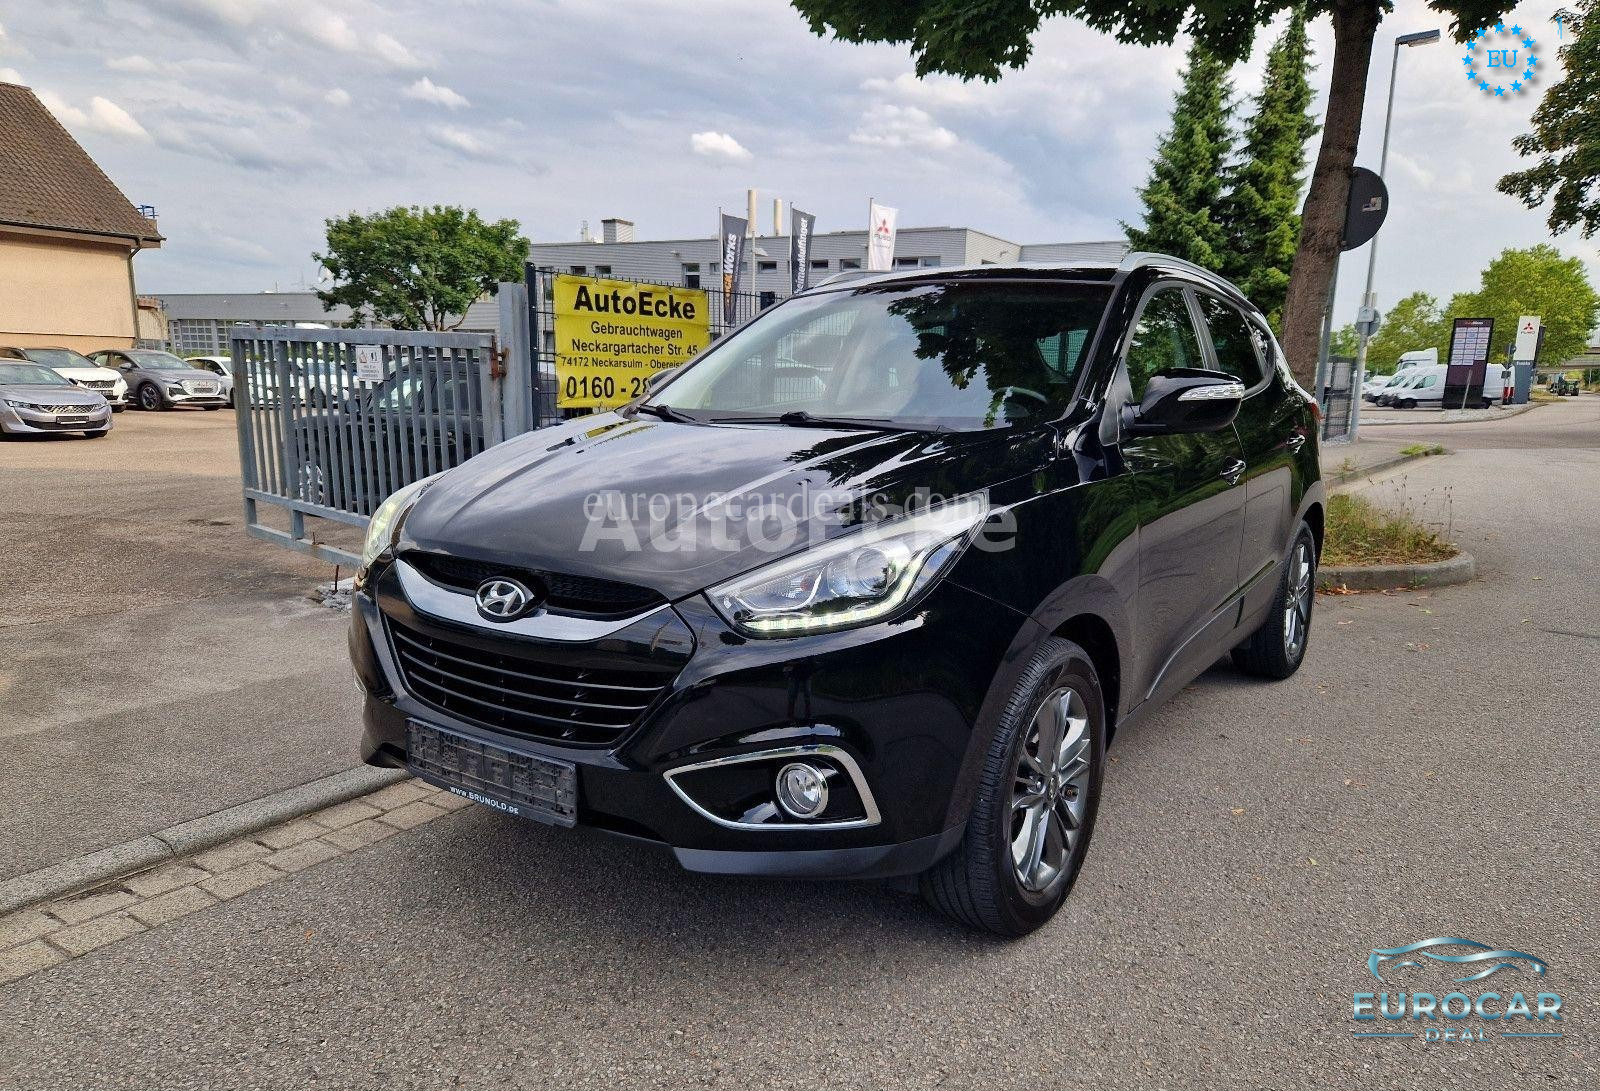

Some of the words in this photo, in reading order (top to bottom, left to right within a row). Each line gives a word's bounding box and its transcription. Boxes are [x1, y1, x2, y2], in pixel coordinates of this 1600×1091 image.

[574, 285, 696, 319] AutoEcke
[590, 321, 683, 340] Gebrauchtwagen
[571, 338, 665, 356] Neckargartacher
[667, 343, 684, 356] Str.
[686, 344, 699, 357] 45
[561, 356, 589, 367] 74172
[591, 357, 643, 369] Neckarsulm
[650, 359, 684, 370] Obereis
[565, 375, 615, 399] 0160
[450, 786, 519, 814] www.BRUNOLD.DE
